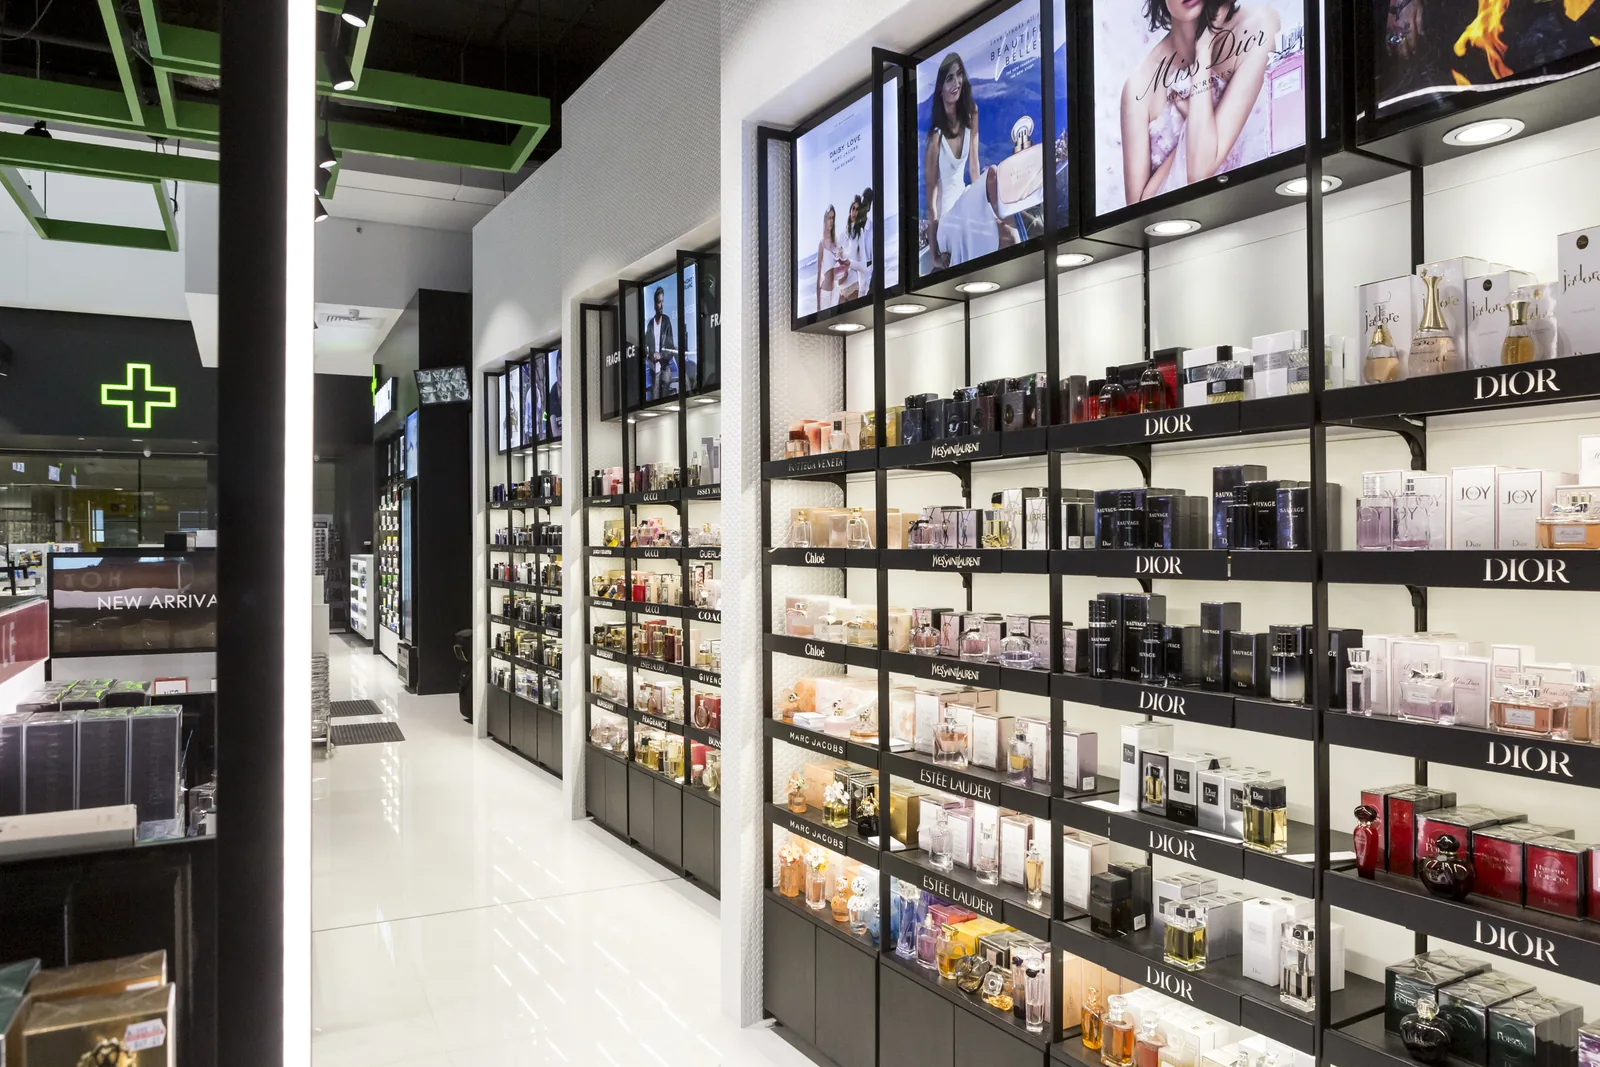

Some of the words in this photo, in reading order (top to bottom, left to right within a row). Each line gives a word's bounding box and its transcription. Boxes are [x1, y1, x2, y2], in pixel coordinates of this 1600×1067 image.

[1005, 40, 1037, 65] BELLE
[1135, 51, 1200, 101] Miss
[1205, 29, 1267, 70] Dior
[829, 144, 845, 159] DAISY
[846, 134, 861, 148] LOVE
[1473, 367, 1561, 401] DIOR
[1144, 413, 1193, 437] DIOR
[788, 460, 816, 473] BOTTEGA
[817, 457, 843, 470] VENETA
[643, 492, 658, 502] GUCCI
[1457, 486, 1491, 501] JOY
[1503, 489, 1537, 505] JOY
[644, 549, 659, 558] GUCCI
[1465, 540, 1482, 548] Dior
[805, 551, 826, 564] Chloé
[1135, 555, 1182, 575] DIOR
[1482, 558, 1570, 584] DIOR
[97, 594, 143, 611] NEW
[645, 605, 660, 614] GUCCI
[805, 643, 826, 658] Chloé
[1138, 691, 1187, 716] DIOR
[642, 715, 667, 730] FRAGRANCE
[789, 731, 810, 744] MARC
[811, 738, 844, 754] JACOBS
[1485, 741, 1574, 778] DIOR
[950, 777, 991, 800] LAUDER
[789, 820, 810, 835] MARC
[812, 829, 844, 849] JACOBS
[1148, 830, 1197, 861] DIOR
[1533, 869, 1569, 885] POISON
[952, 887, 994, 916] LAUDER
[1473, 920, 1559, 967] DIOR
[1145, 965, 1194, 1002] DIOR
[1496, 1031, 1527, 1050] POISON
